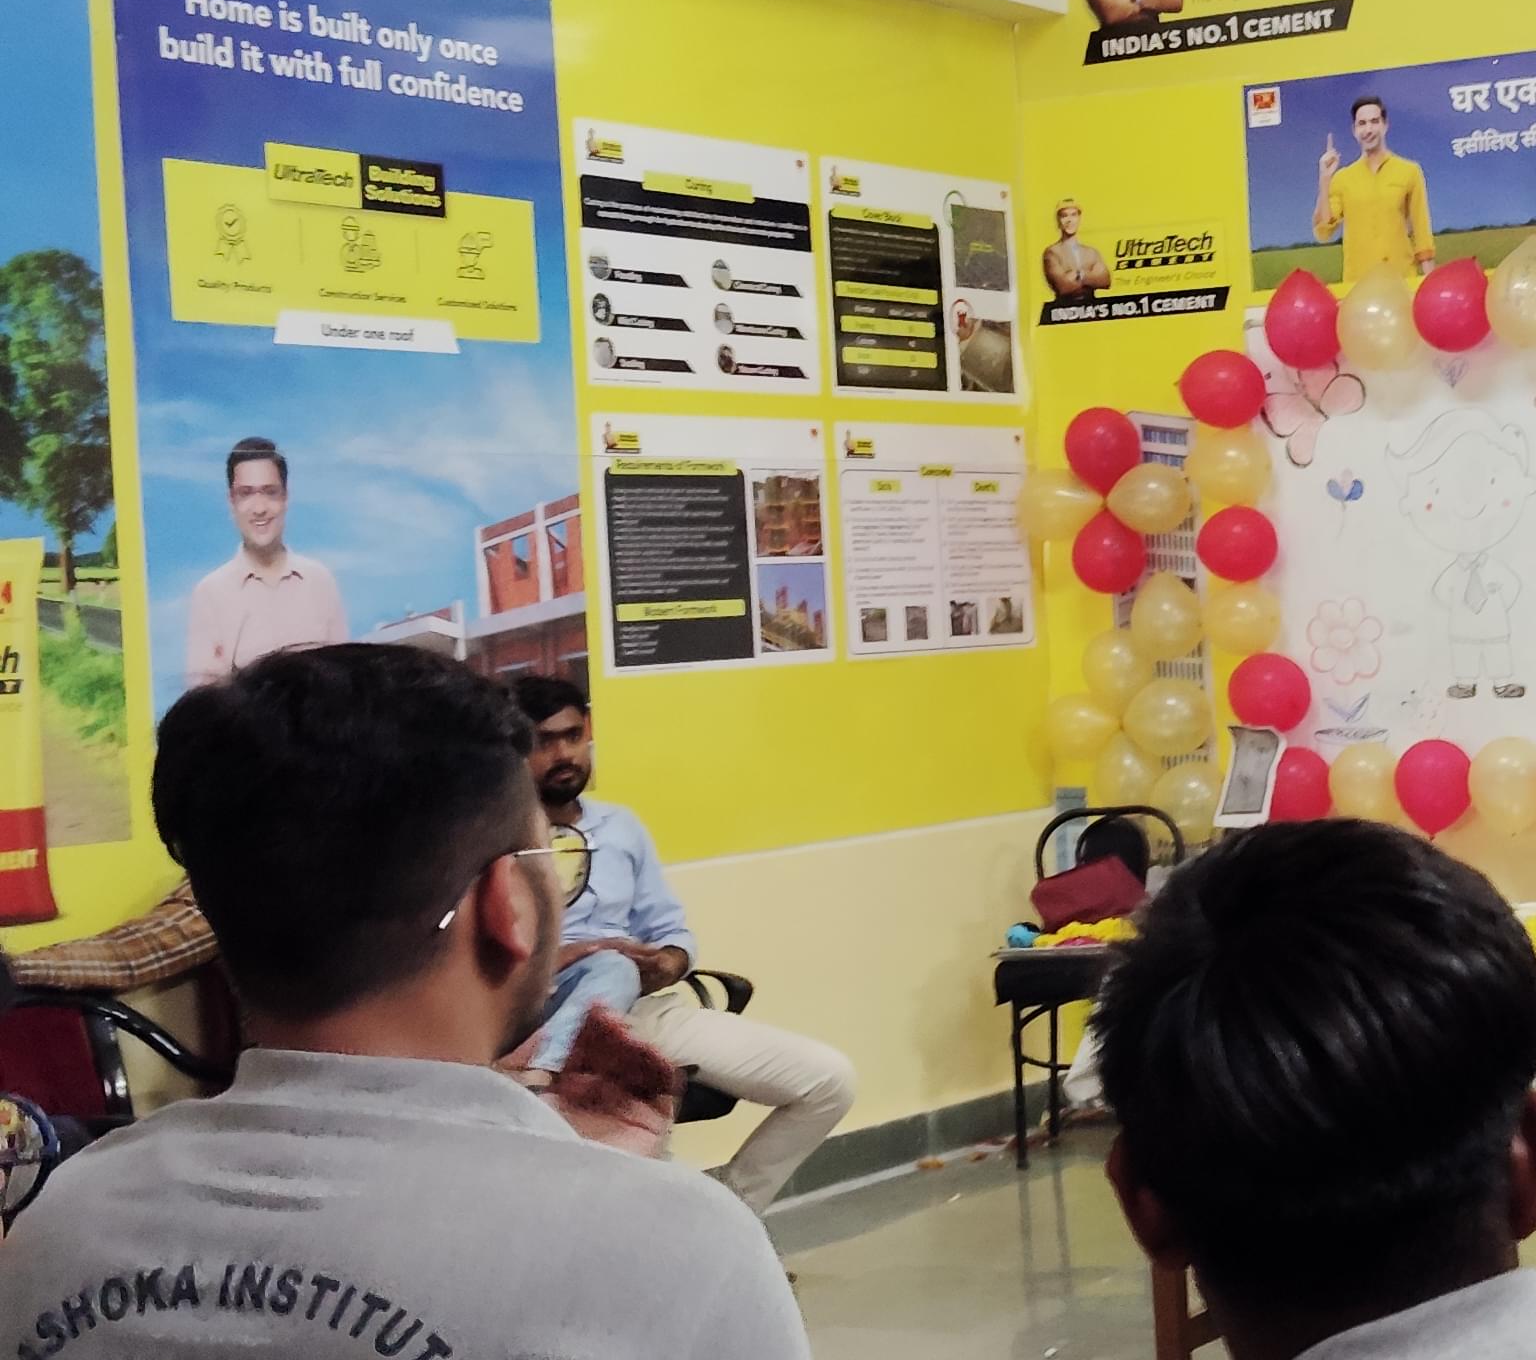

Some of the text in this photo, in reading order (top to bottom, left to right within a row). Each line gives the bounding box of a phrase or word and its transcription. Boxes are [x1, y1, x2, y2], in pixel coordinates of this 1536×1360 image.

[278, 0, 303, 33] is
[308, 4, 373, 46] built
[376, 22, 434, 63] only
[438, 37, 499, 67] once
[1101, 7, 1336, 58] INDIA'S NO.1 CEMENT
[158, 24, 525, 113] build it with full confidence
[1448, 81, 1493, 114] घर
[1451, 127, 1519, 159] इसीलिए
[274, 163, 355, 190] UltraTech
[1114, 230, 1214, 259] UltraTech
[1050, 293, 1217, 322] INDIA'S NO.1 CEMENT
[320, 323, 416, 342] Under one roof
